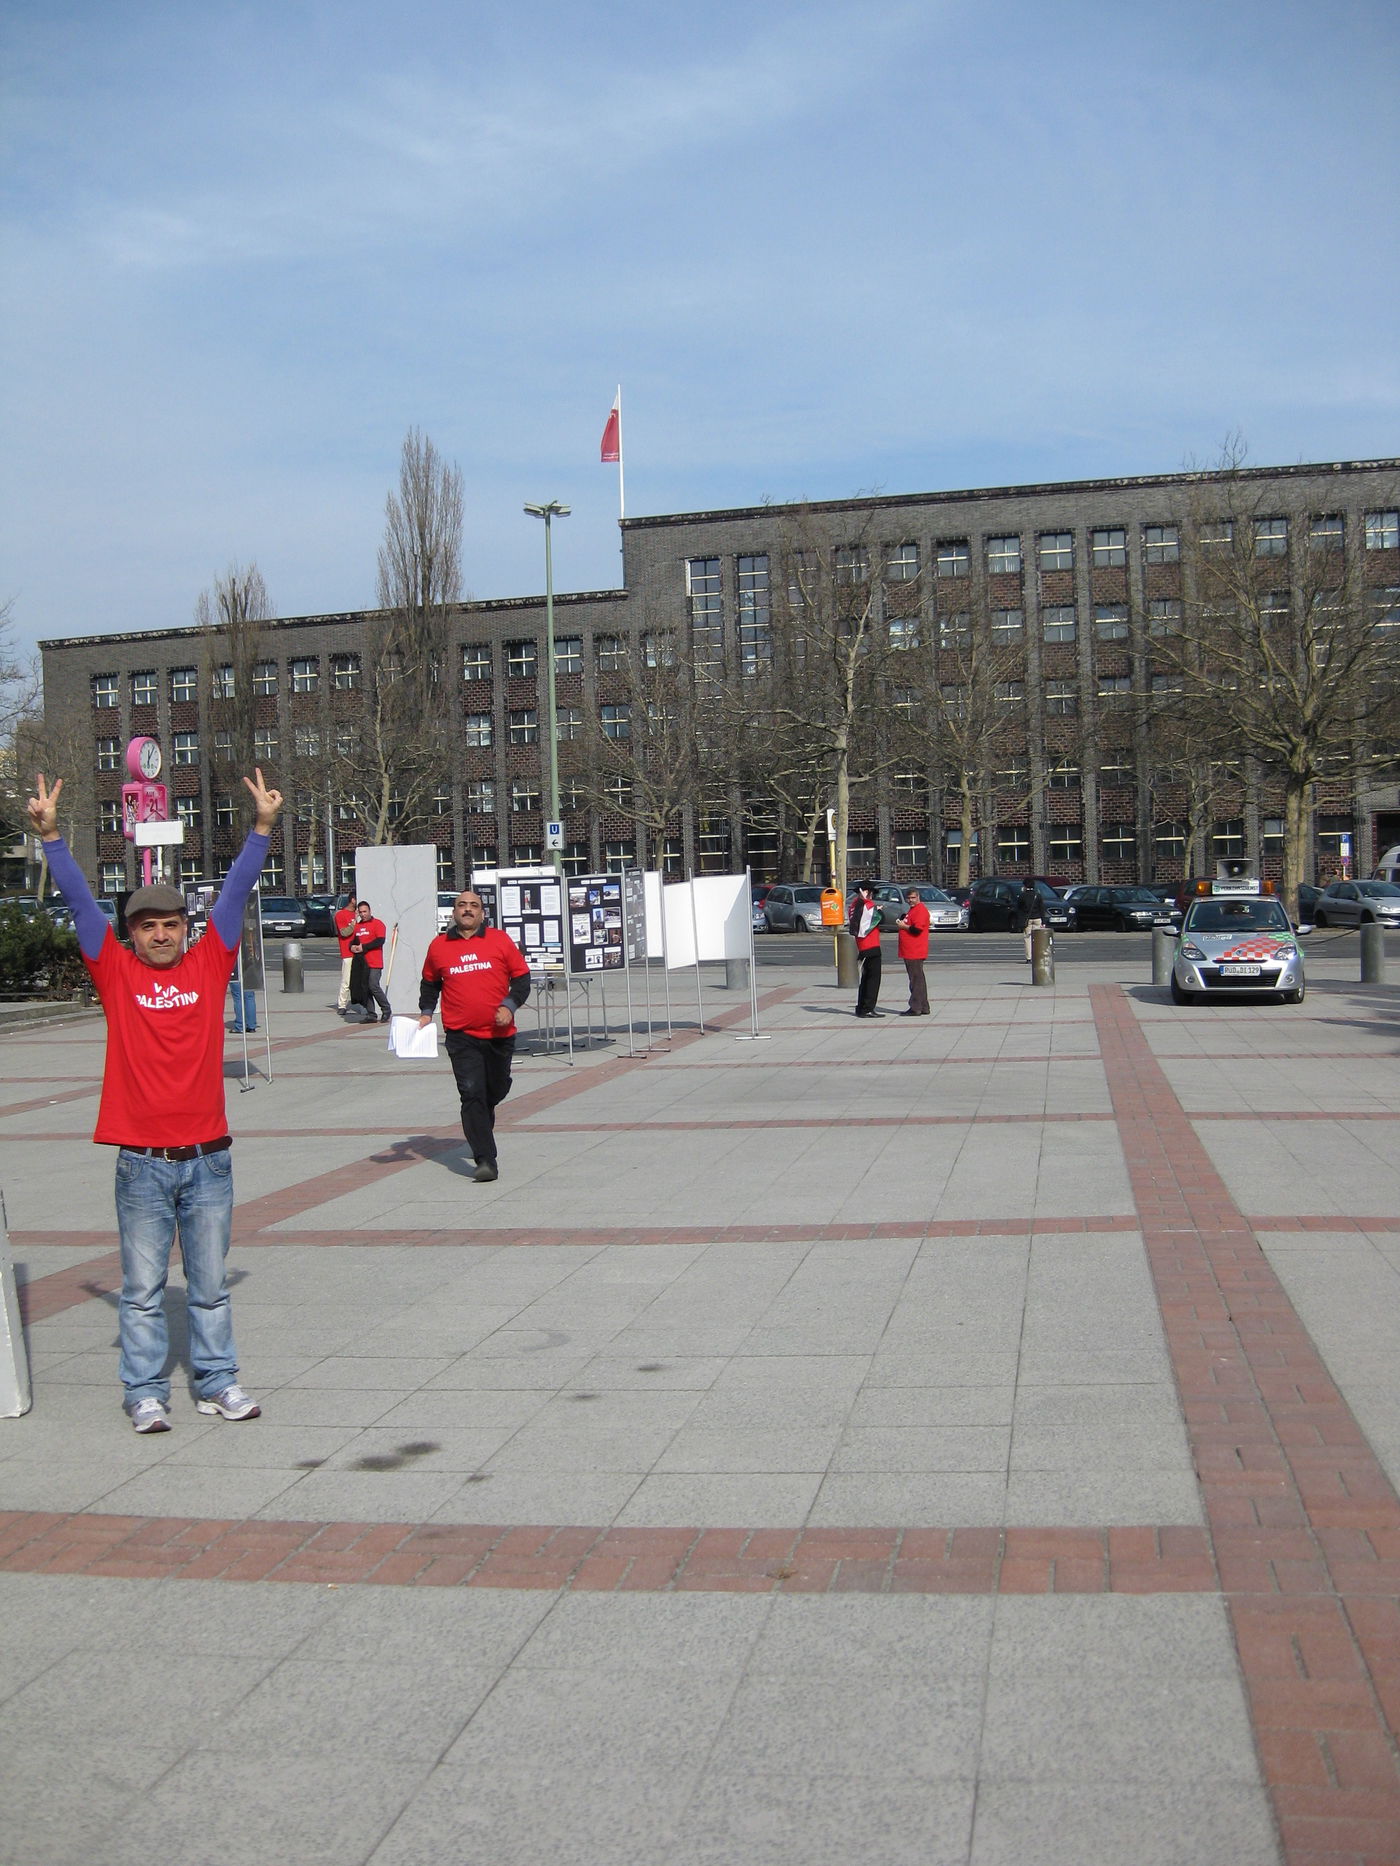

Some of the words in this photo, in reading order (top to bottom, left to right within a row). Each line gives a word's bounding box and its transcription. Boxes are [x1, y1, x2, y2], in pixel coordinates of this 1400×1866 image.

[551, 825, 558, 834] U
[1341, 834, 1347, 842] P
[460, 953, 478, 963] VIVA
[449, 961, 492, 975] PALESTINA
[154, 982, 179, 998] VVA
